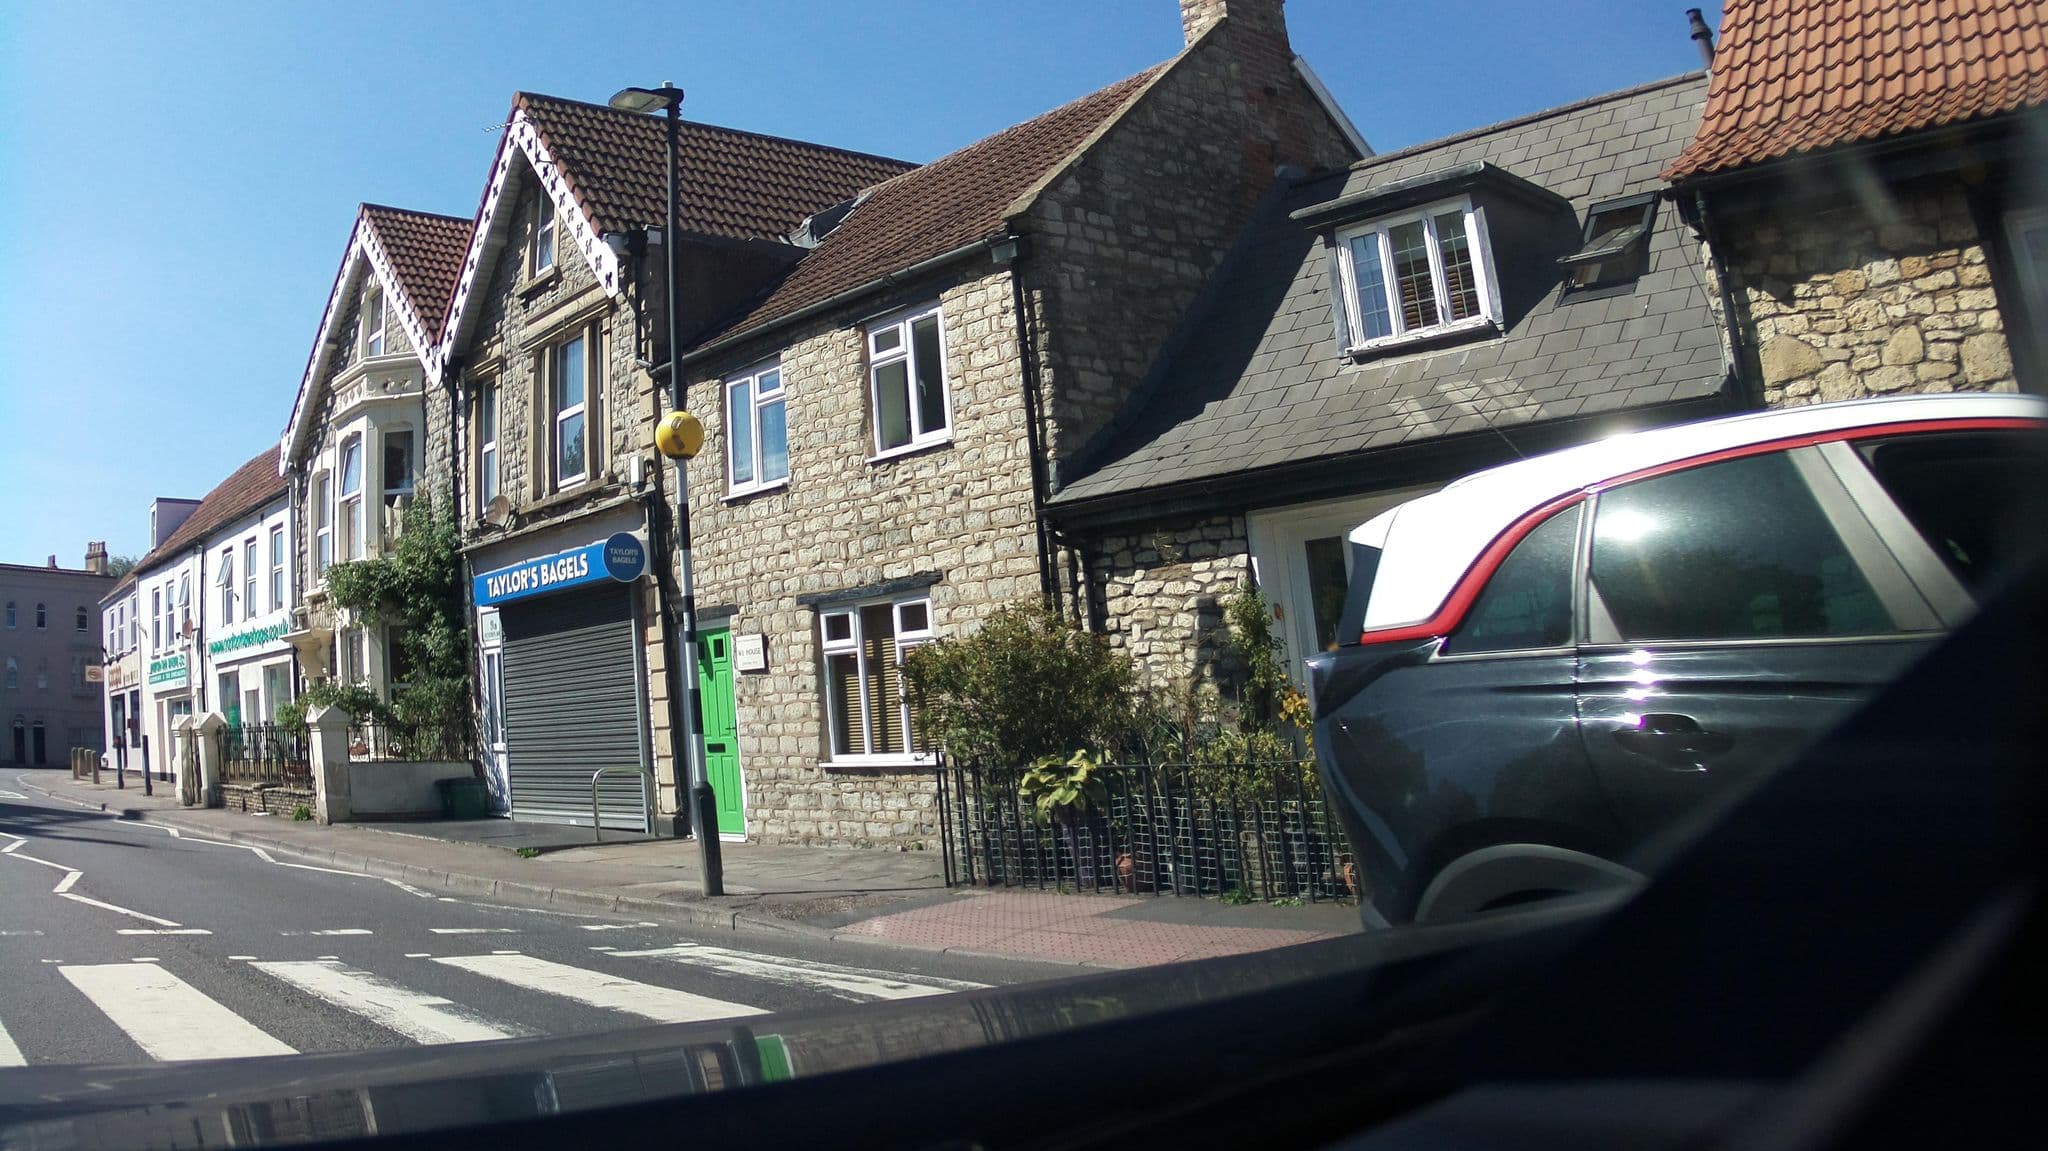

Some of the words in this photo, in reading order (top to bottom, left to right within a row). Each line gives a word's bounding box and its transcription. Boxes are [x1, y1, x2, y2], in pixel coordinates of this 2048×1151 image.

[610, 548, 639, 557] TAYLOR'S
[612, 556, 637, 564] BAGELS
[487, 565, 539, 598] TAYLOR'S
[540, 553, 589, 586] BAGELS
